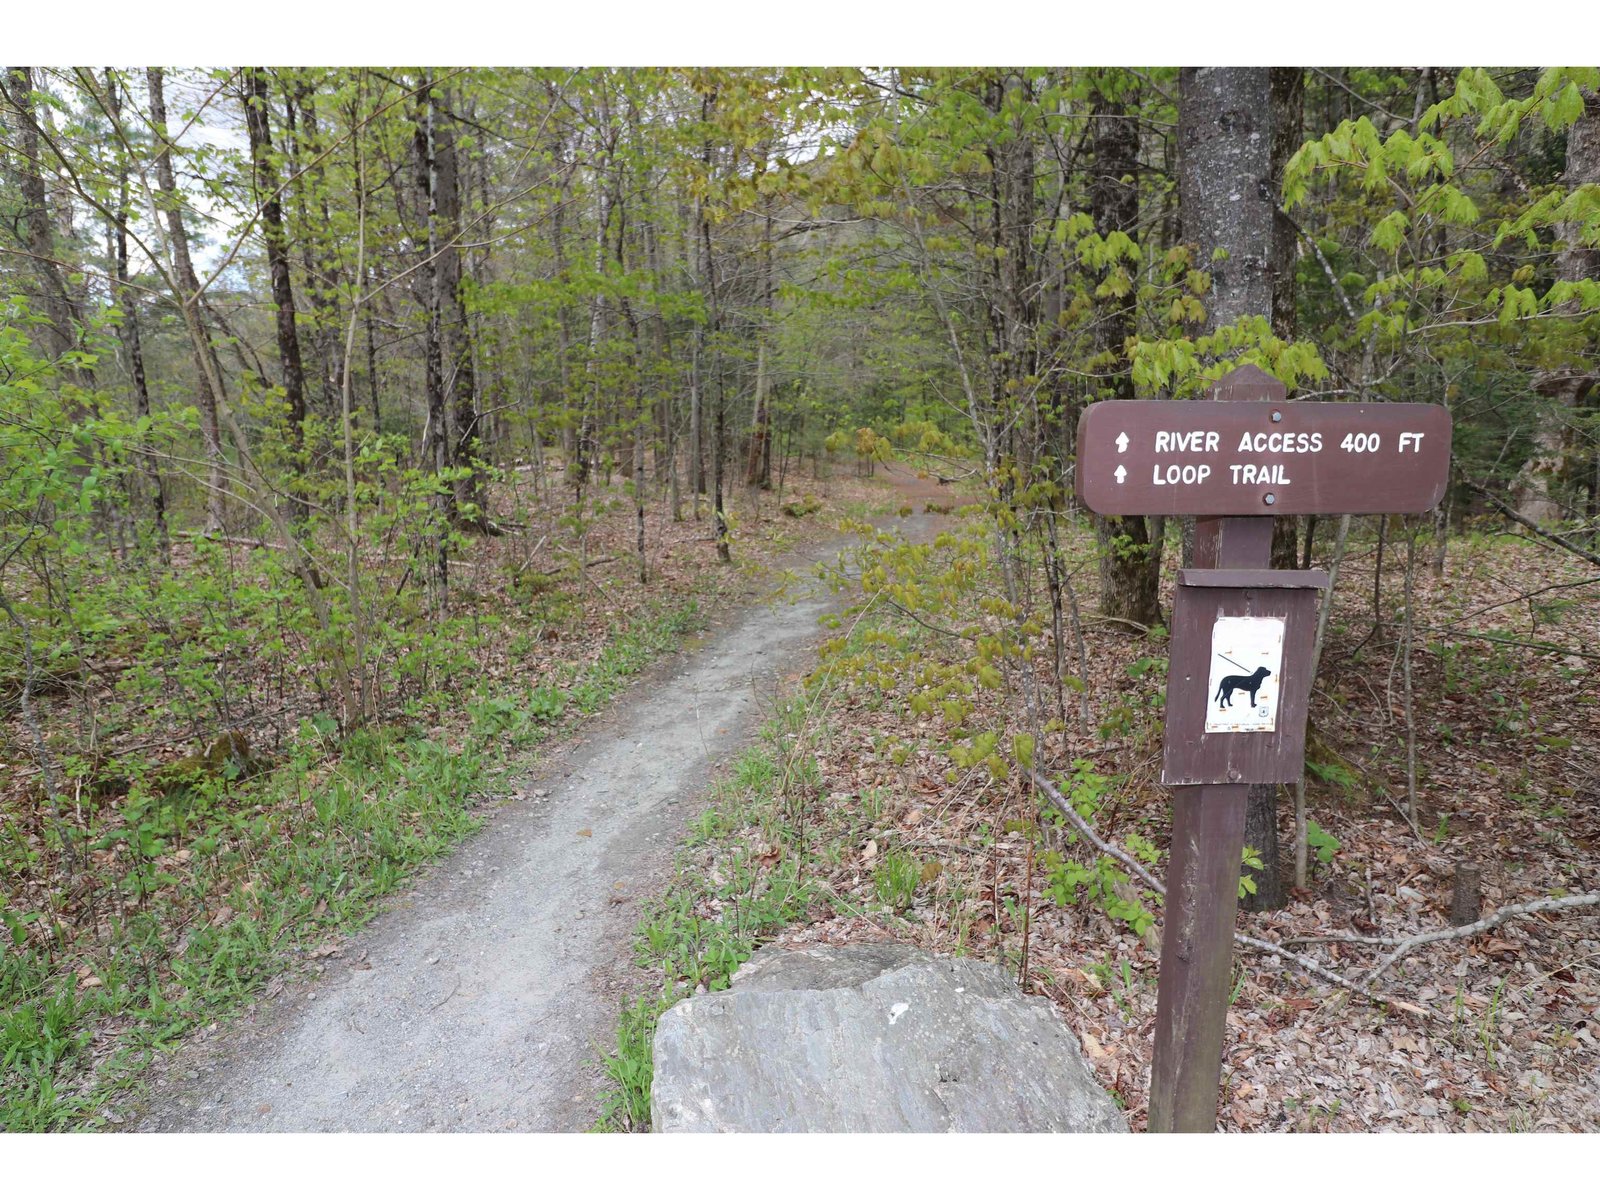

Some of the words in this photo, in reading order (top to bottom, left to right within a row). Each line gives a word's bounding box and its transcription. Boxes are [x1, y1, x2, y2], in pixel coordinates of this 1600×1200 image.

[1154, 430, 1220, 454] RIVER
[1237, 432, 1323, 454] ACCESS
[1340, 432, 1381, 453] 400
[1398, 431, 1425, 453] FT
[1152, 463, 1212, 485] LOOP
[1229, 463, 1291, 485] TRAIL
